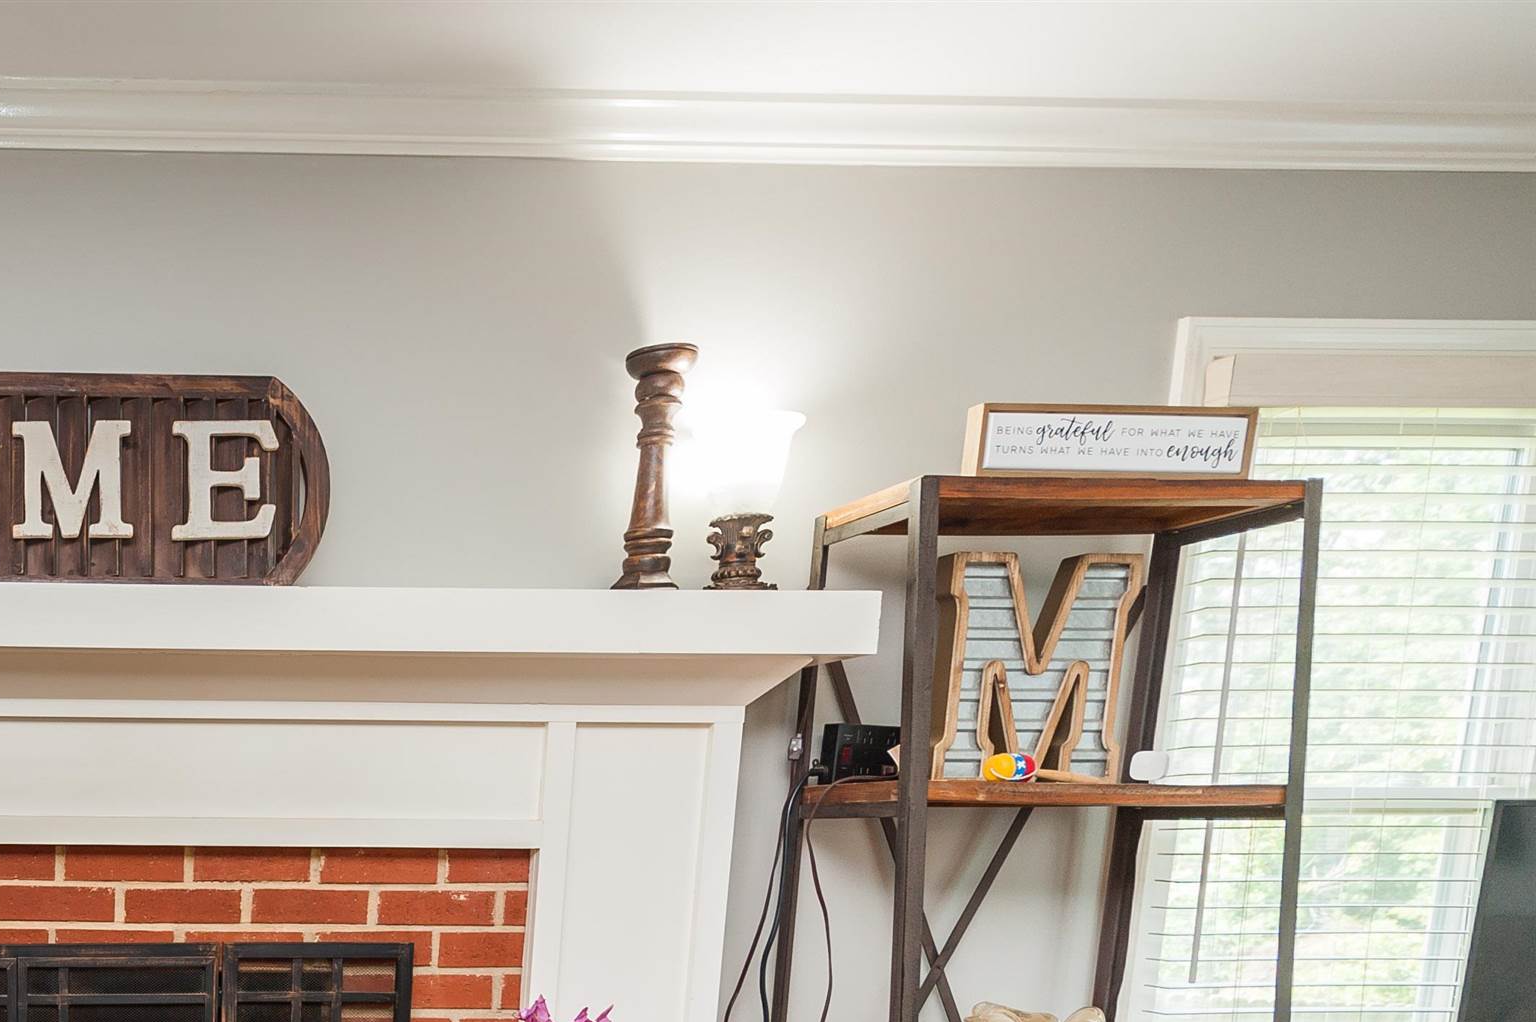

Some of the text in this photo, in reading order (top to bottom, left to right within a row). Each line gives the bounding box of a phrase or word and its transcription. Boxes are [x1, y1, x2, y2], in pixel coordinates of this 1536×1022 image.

[996, 416, 1240, 446] BEING grateful FOR WHAT WE HAVE
[995, 438, 1238, 468] TURNS WHAT WE HAVE INTO enough
